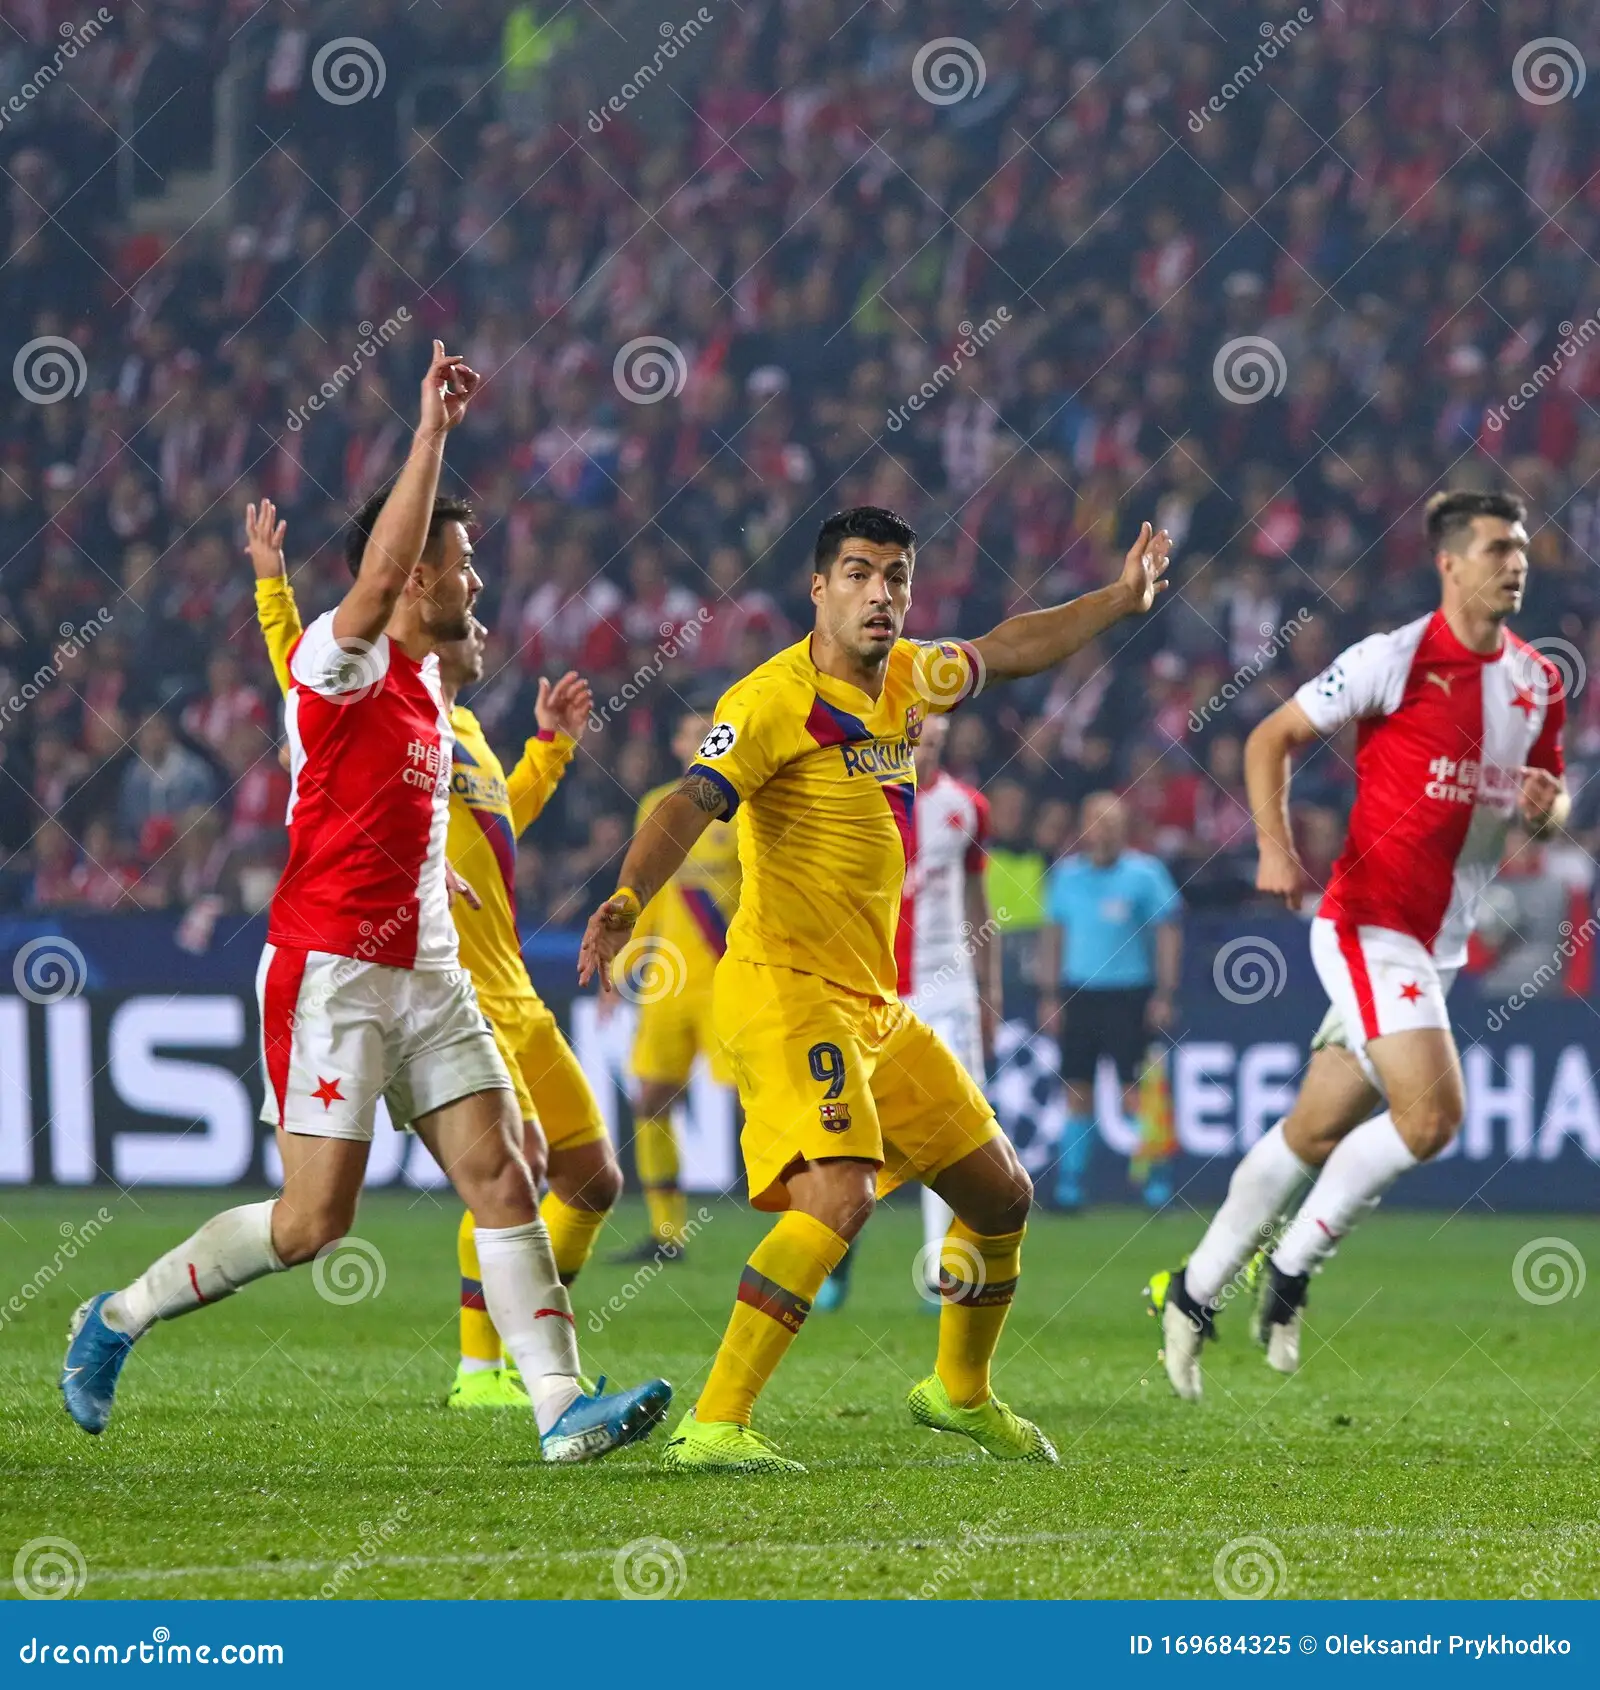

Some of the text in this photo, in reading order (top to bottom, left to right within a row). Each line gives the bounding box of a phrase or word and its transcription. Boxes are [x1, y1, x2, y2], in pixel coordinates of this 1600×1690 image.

[840, 737, 914, 777] Rakute
[808, 1042, 845, 1099] 9
[1095, 1041, 1600, 1160] UEF HA
